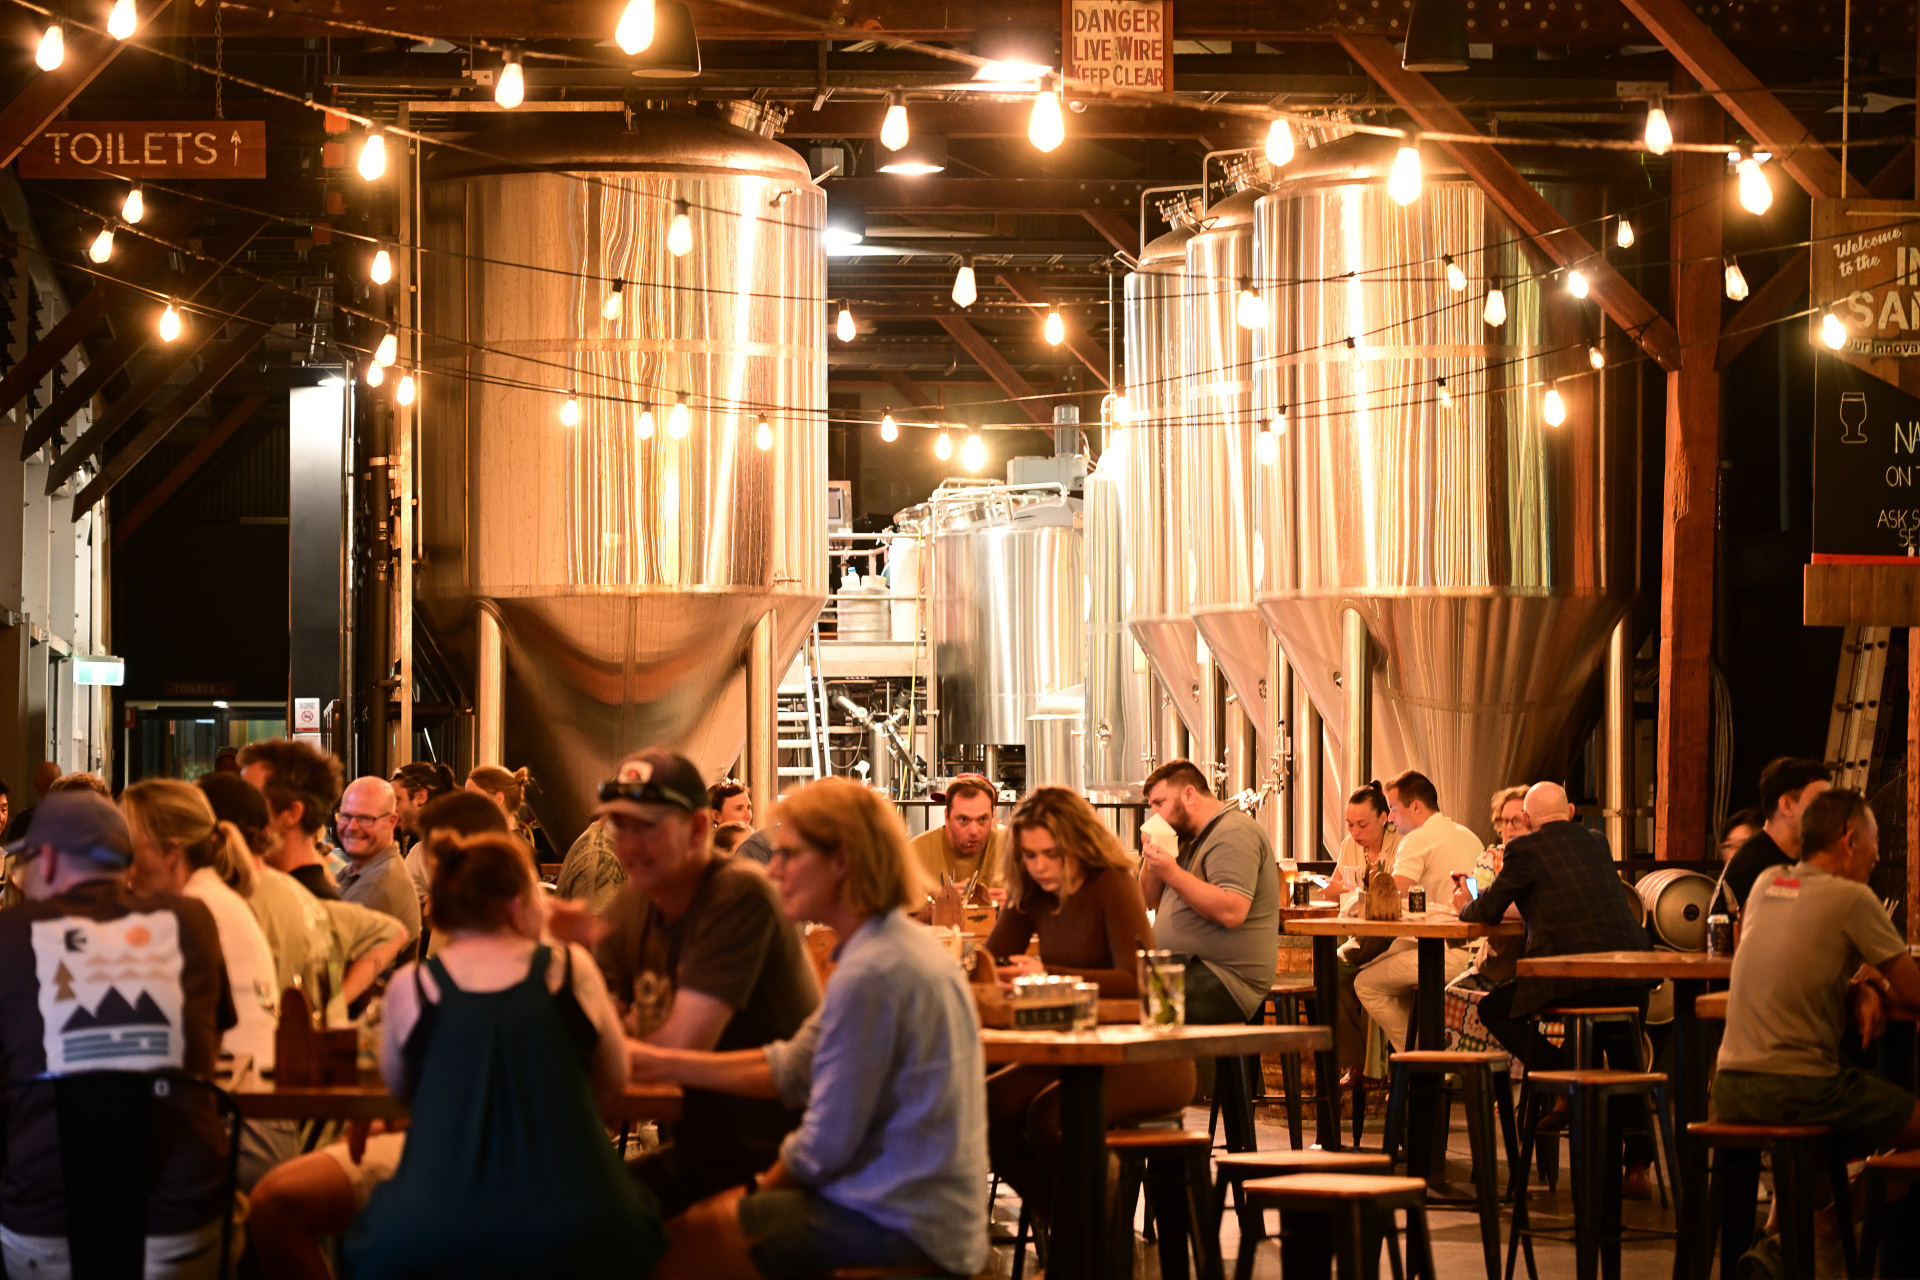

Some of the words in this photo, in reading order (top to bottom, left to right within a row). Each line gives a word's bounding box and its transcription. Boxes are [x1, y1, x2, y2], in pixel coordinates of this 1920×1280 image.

[1074, 9, 1161, 33] DANGER
[1073, 36, 1112, 62] LIVE
[1116, 36, 1163, 62] WIRE
[1113, 64, 1163, 87] CLEAR
[44, 132, 218, 165] TOILETS
[1833, 228, 1902, 258] Welcome
[1839, 261, 1854, 278] to
[1854, 254, 1880, 272] the
[1871, 341, 1920, 355] Innova
[1885, 465, 1912, 487] ON
[1877, 508, 1908, 529] ASK
[1899, 527, 1920, 547] SE
[173, 683, 216, 693] TOILETS
